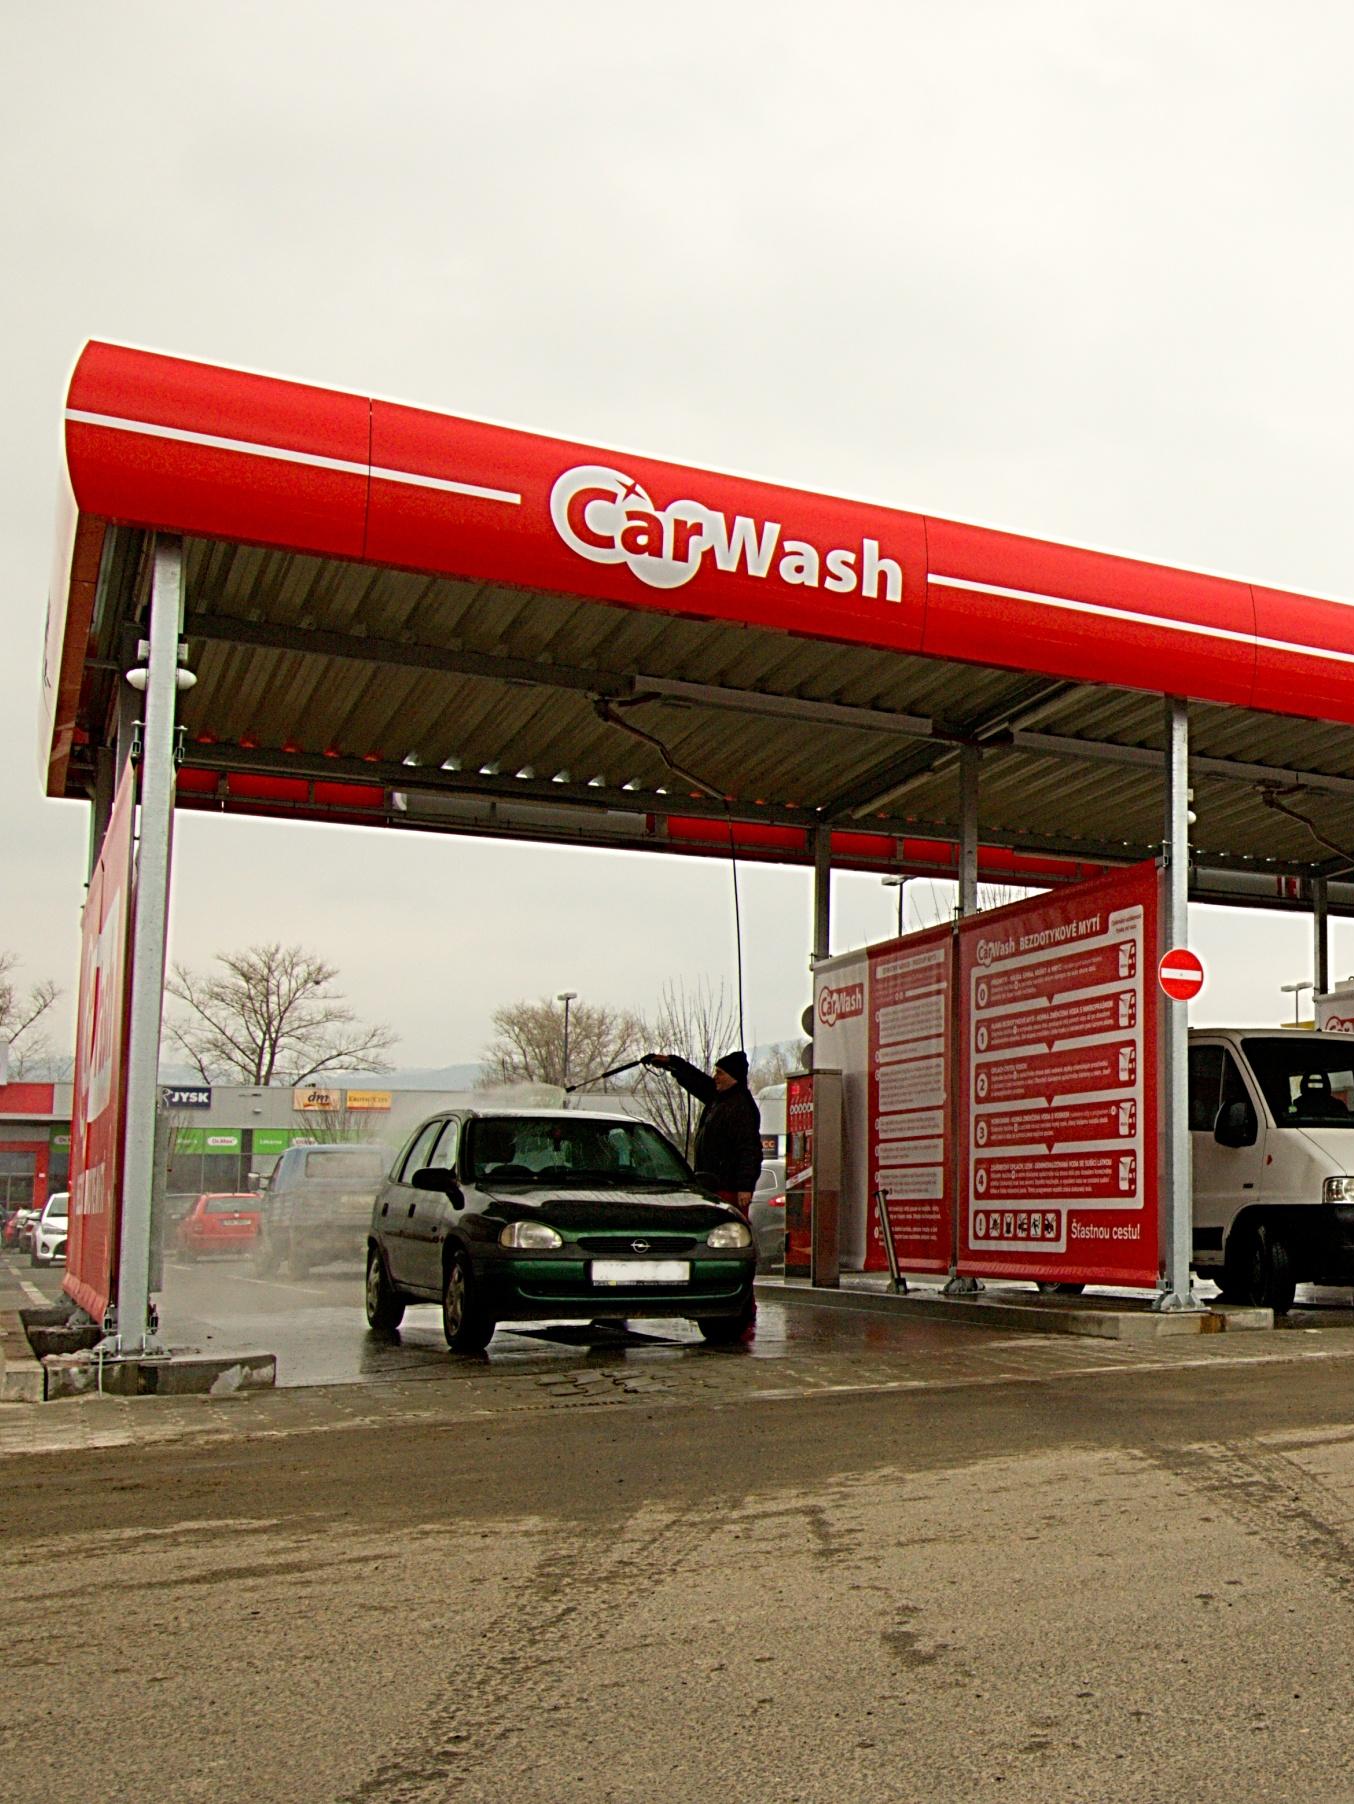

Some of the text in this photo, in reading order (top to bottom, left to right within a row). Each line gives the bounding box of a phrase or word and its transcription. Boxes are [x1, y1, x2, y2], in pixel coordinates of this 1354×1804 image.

[551, 465, 902, 603] CarWash
[1020, 923, 1077, 951] BEZDOTYKOVÉ
[1078, 914, 1100, 935] MYTÍ
[820, 987, 862, 1024] CarWash
[172, 1092, 209, 1103] JYSK
[308, 1091, 330, 1103] dm
[1071, 1219, 1141, 1240] Šťastnou cestu!
